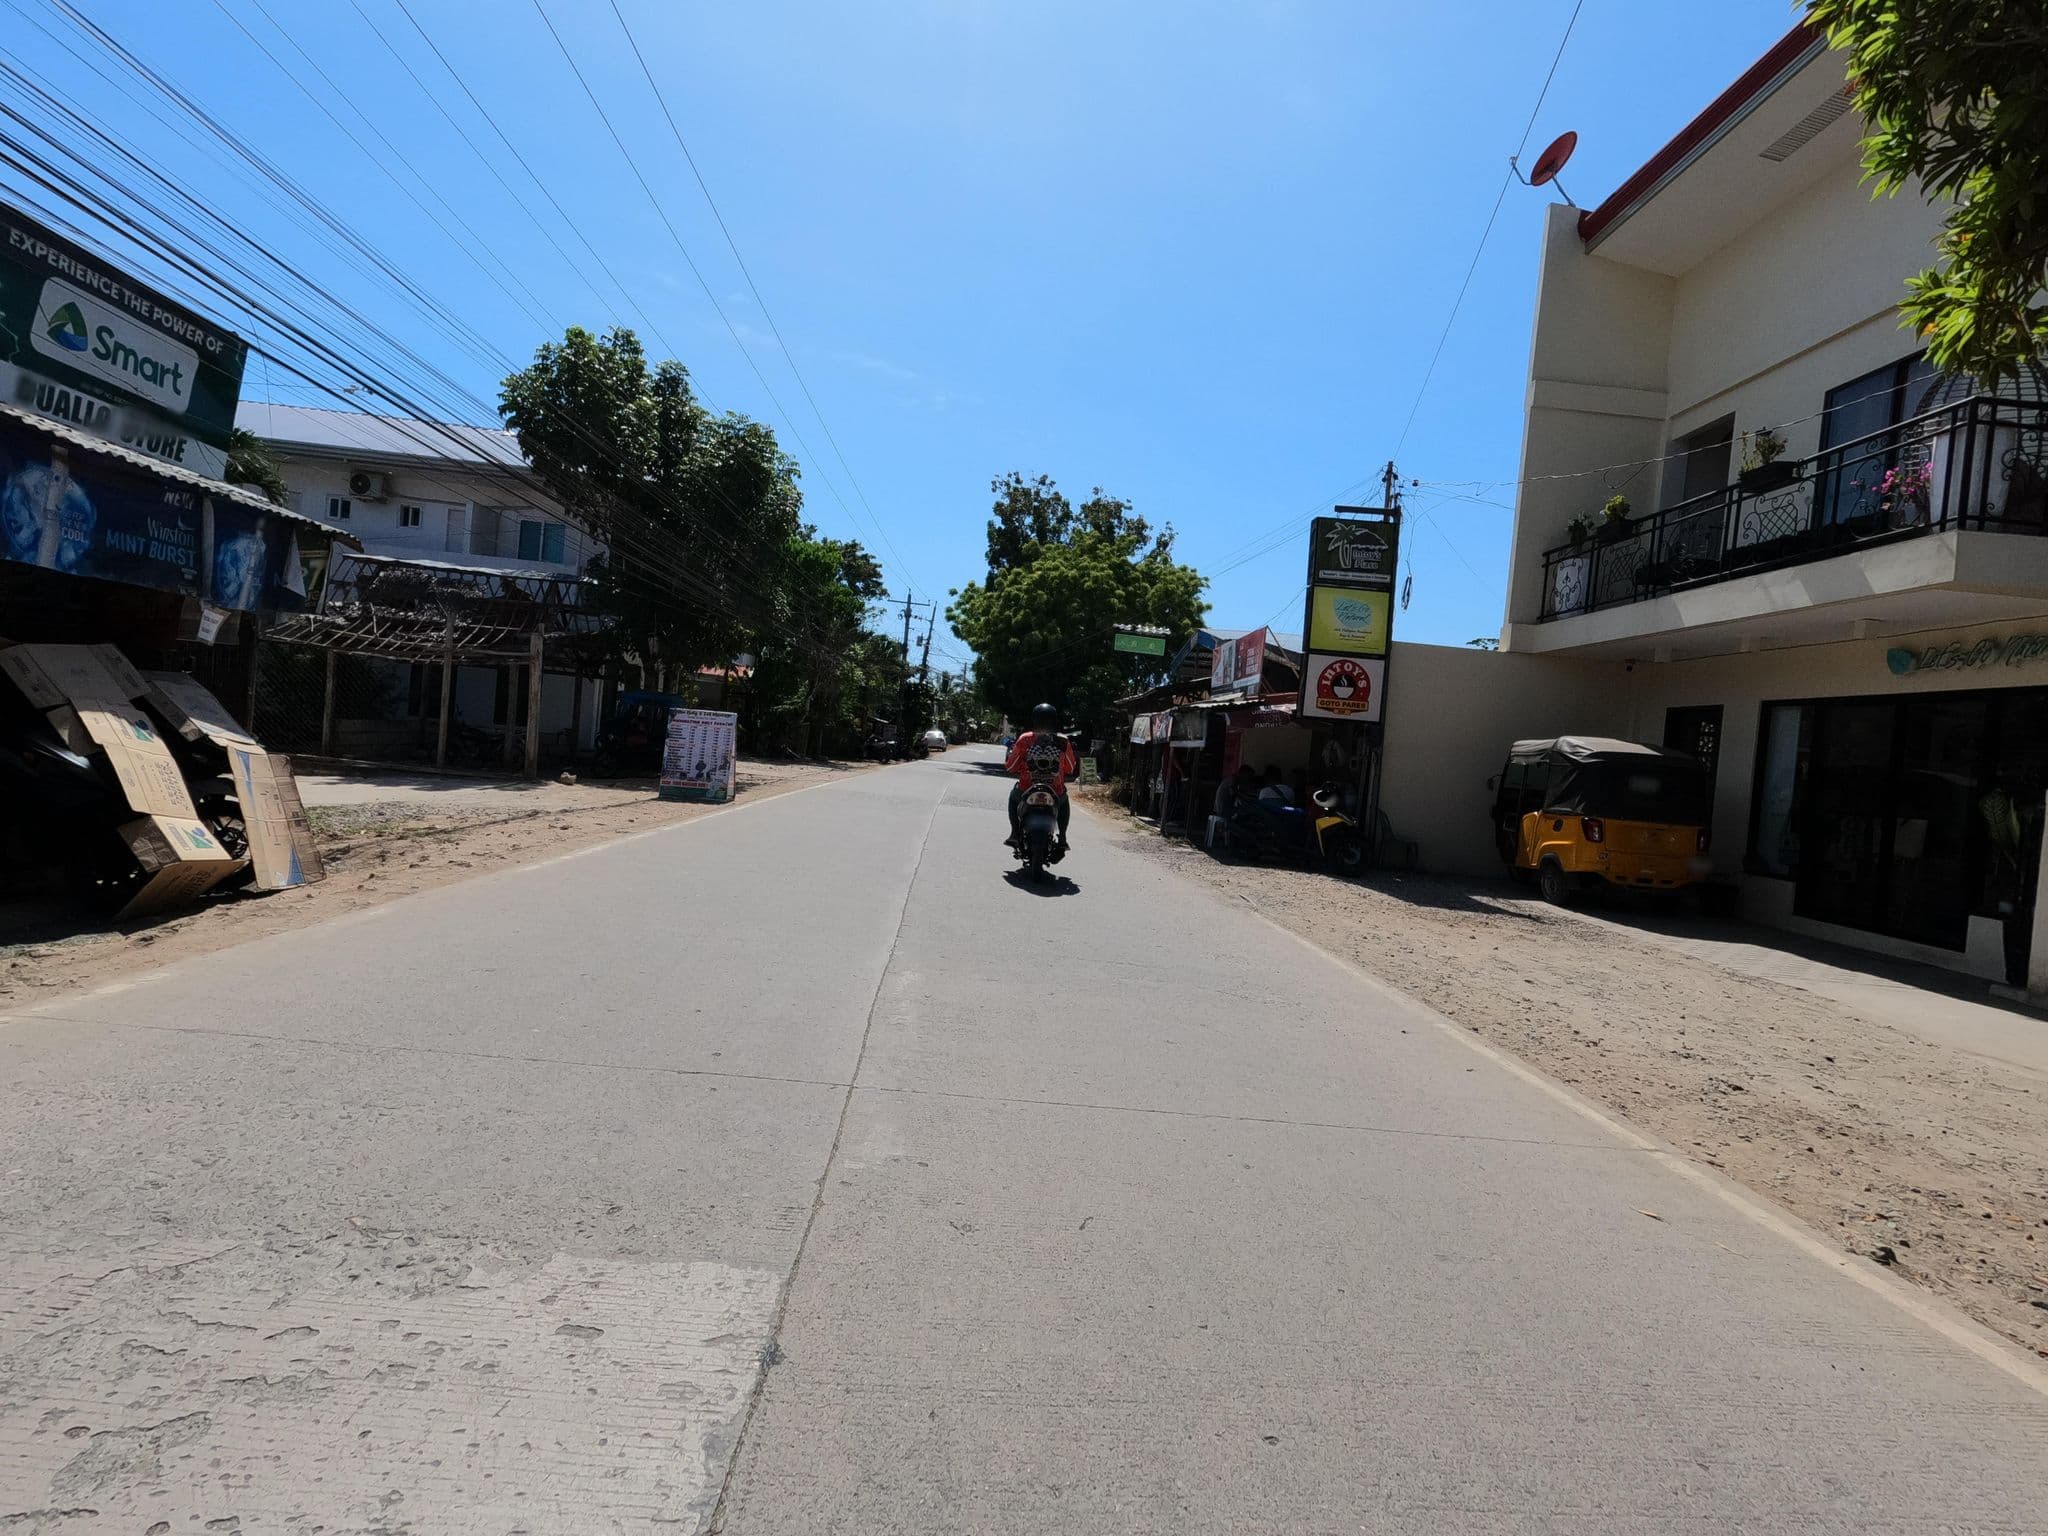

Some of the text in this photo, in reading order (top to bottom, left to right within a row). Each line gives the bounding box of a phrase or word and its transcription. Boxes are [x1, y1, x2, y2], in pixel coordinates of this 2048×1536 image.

[9, 231, 223, 354] EXPERIENCE THE POWER OF
[92, 325, 184, 396] Smart
[105, 529, 197, 568] MINT BURST
[147, 516, 195, 546] Winston
[1319, 699, 1341, 707] GOTO
